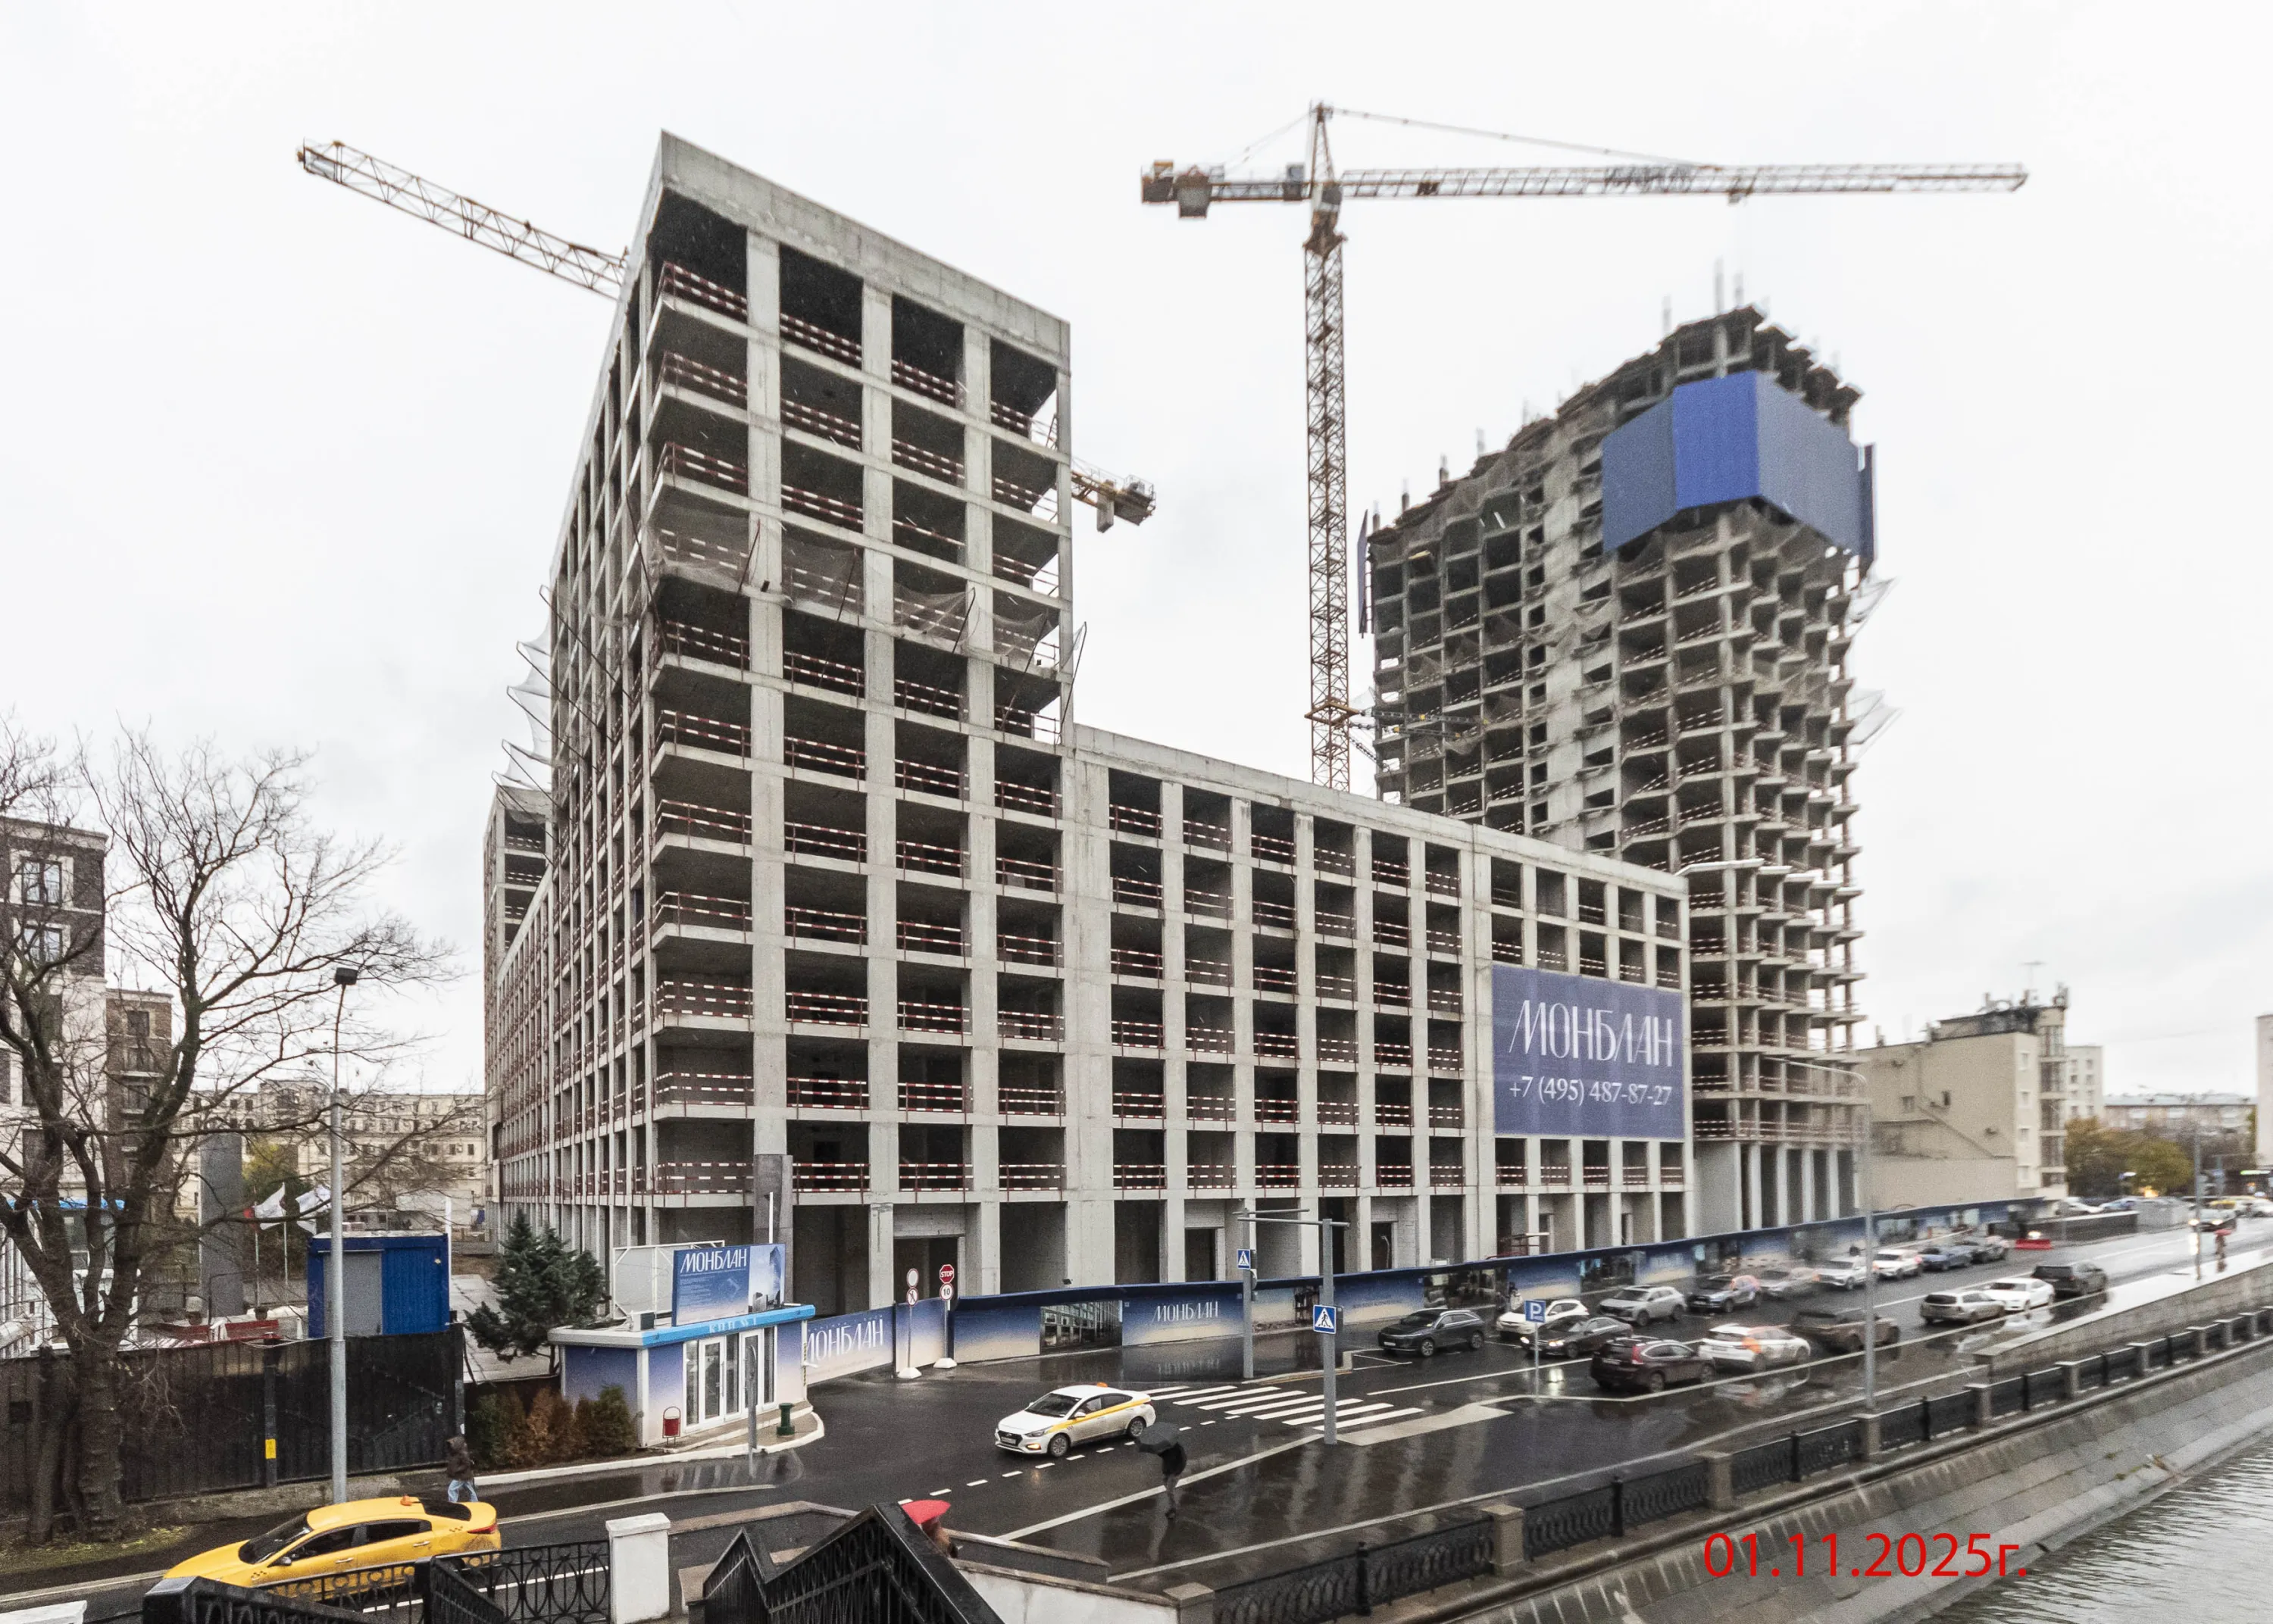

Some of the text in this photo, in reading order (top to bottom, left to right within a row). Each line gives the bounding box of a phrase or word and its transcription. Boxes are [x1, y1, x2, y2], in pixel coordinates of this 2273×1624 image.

[1509, 999, 1673, 1067] МОНБЛАН
[1509, 1076, 1672, 1107] +7 (495) 487-87-27
[680, 1248, 747, 1273] МОНБЛАН
[943, 1288, 950, 1296] 10
[1150, 1301, 1218, 1324] МОНБЛАН
